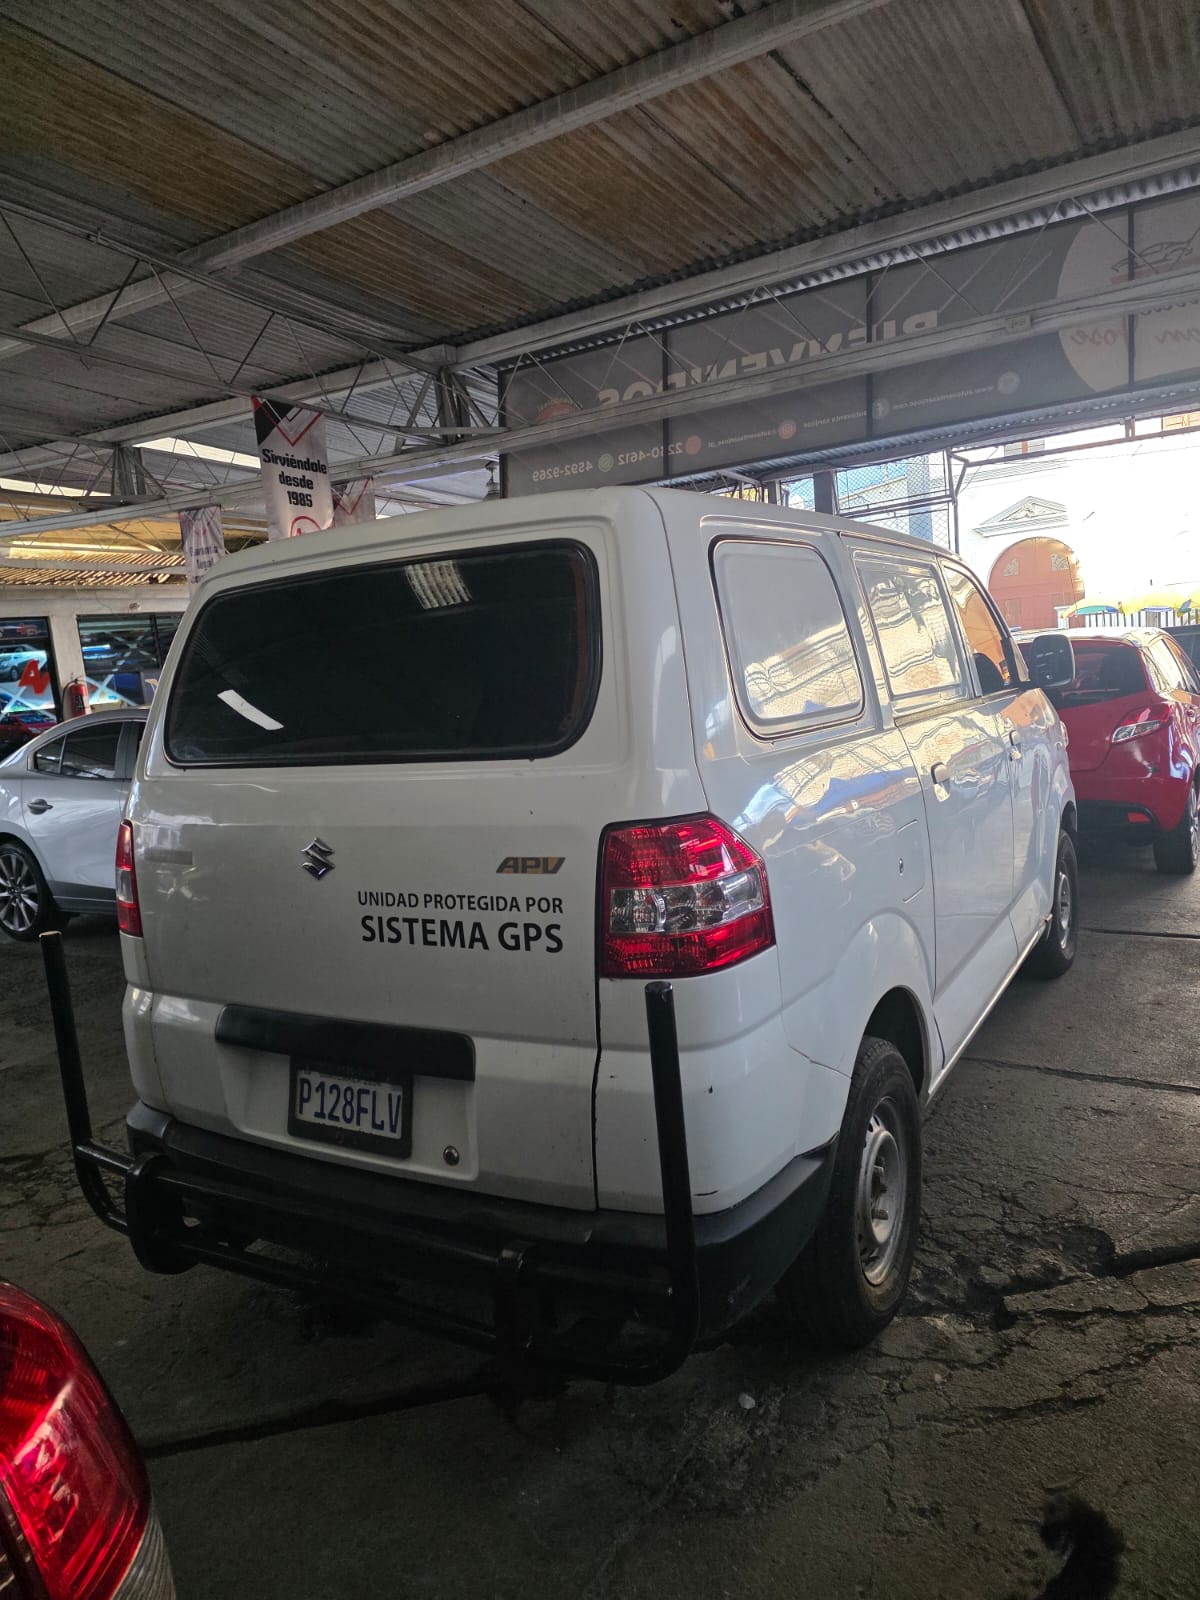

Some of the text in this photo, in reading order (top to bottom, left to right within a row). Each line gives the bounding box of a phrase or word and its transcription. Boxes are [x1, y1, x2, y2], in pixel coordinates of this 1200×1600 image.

[262, 449, 327, 475] Sirviéndole
[278, 471, 314, 490] desde
[287, 490, 313, 508] 1985
[496, 856, 566, 874] APV
[357, 891, 564, 914] UNIDAD PROTEGIDA POR
[360, 915, 564, 953] SISTEMA GPS
[298, 1077, 402, 1134] P128FLV
